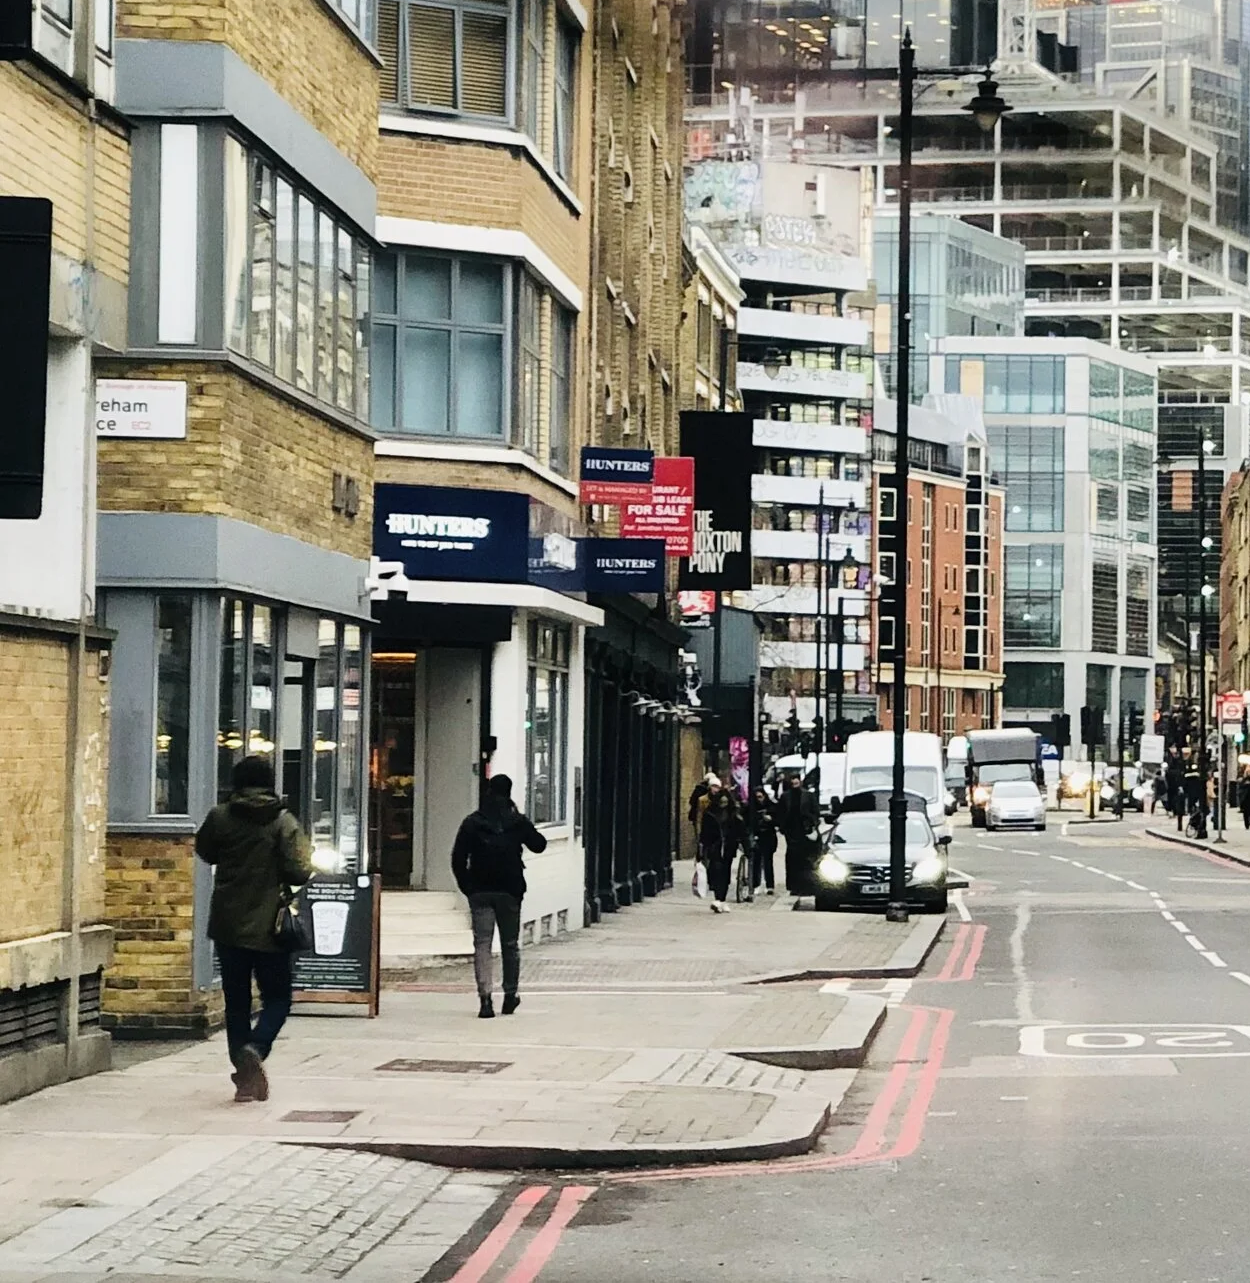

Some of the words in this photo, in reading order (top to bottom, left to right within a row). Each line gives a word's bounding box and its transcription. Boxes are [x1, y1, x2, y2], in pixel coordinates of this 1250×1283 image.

[584, 458, 650, 472] HUNTERS
[667, 496, 692, 504] LEASE
[627, 505, 652, 516] FOR
[655, 505, 687, 516] SALE
[385, 513, 491, 538] HUNTERS
[595, 558, 658, 569] HUNTERS
[688, 551, 725, 573] PONY
